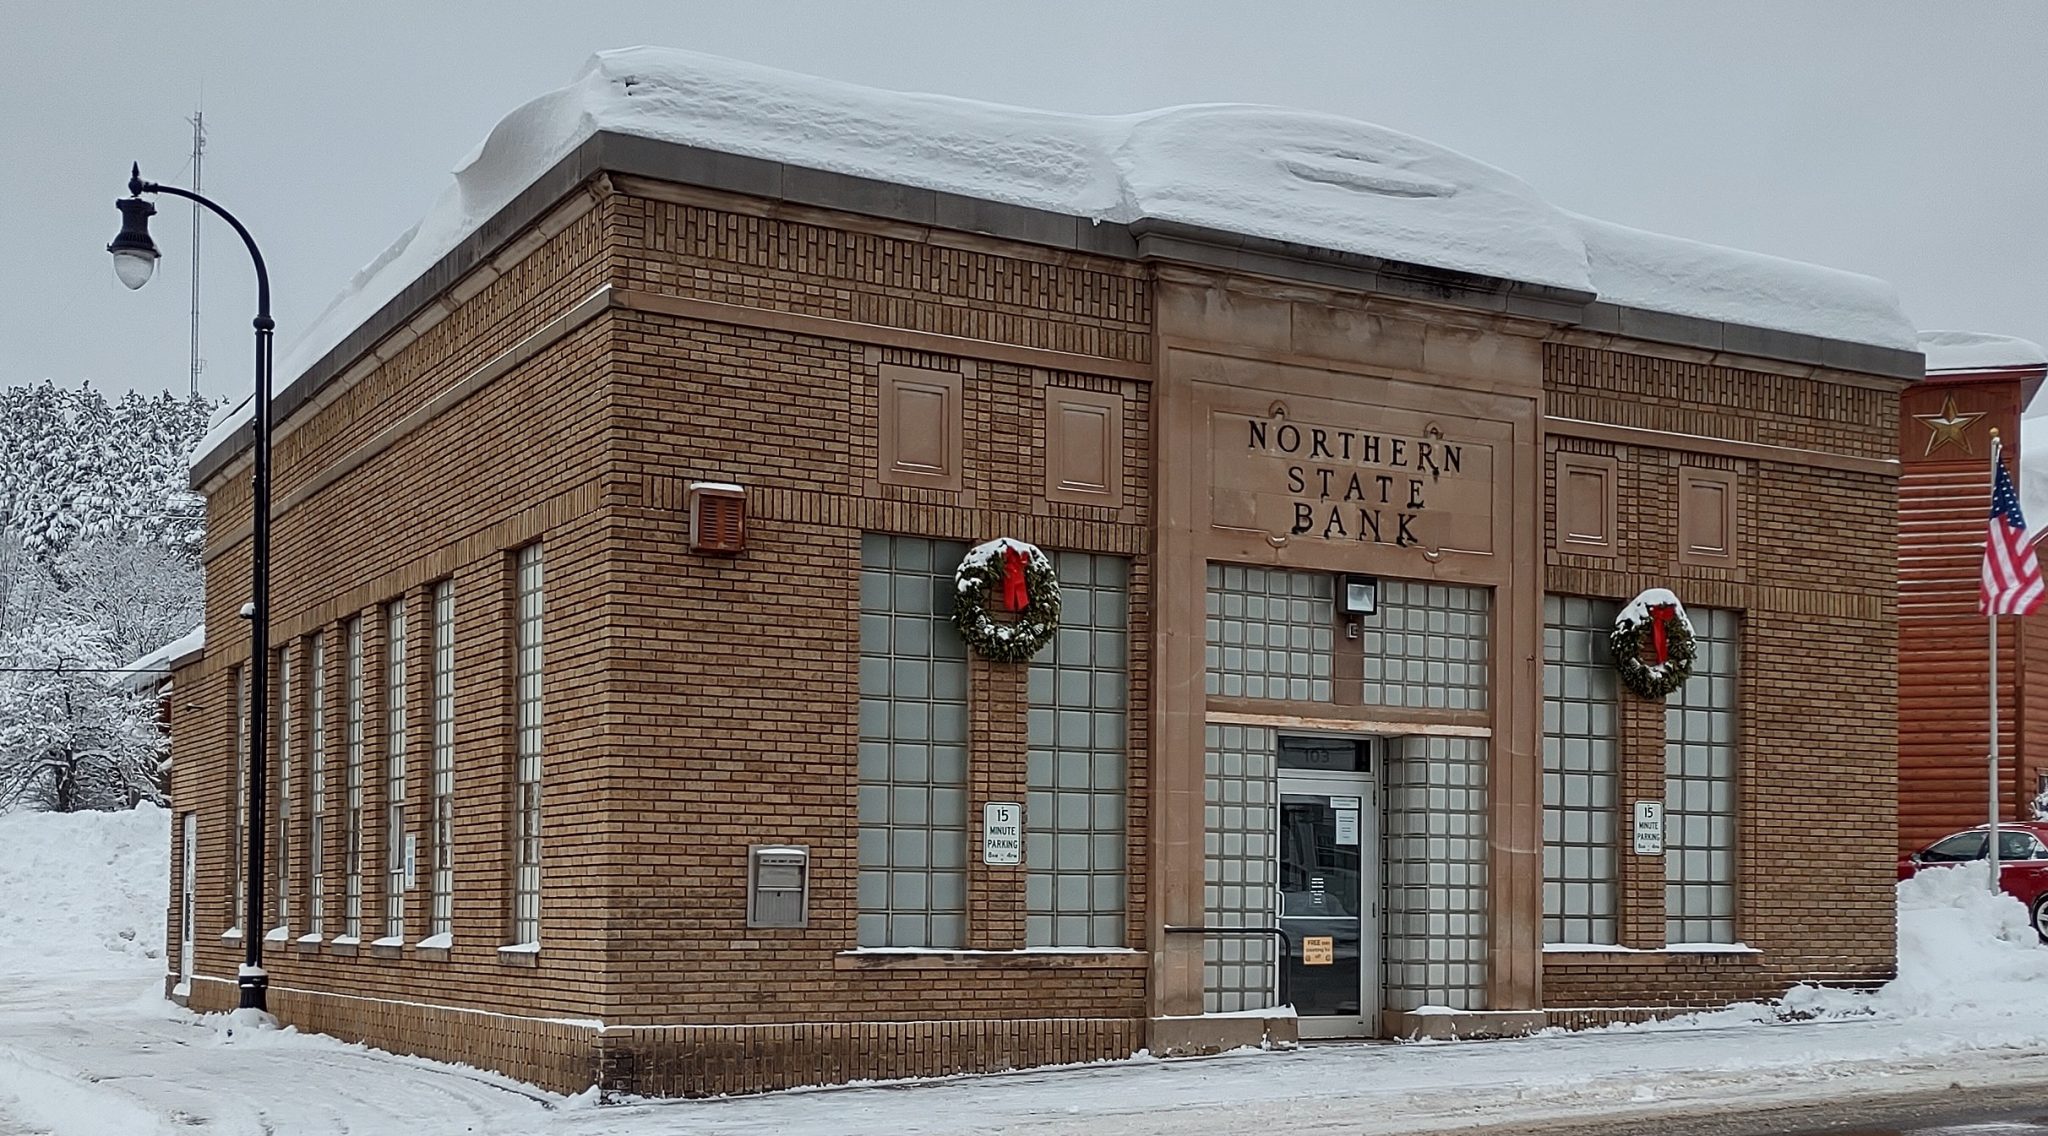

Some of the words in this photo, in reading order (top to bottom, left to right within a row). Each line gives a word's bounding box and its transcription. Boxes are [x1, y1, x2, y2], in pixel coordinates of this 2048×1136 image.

[1248, 420, 1462, 475] NORTHERN
[1288, 466, 1425, 509] STATE
[1292, 502, 1418, 546] BANK
[1304, 750, 1330, 763] 103
[996, 809, 1009, 822] 15
[1644, 807, 1654, 818] 15
[990, 826, 1016, 835] MINUTE
[1639, 822, 1659, 830] MINUTE
[1637, 832, 1660, 841] PARKING
[987, 839, 1018, 849] PARKING
